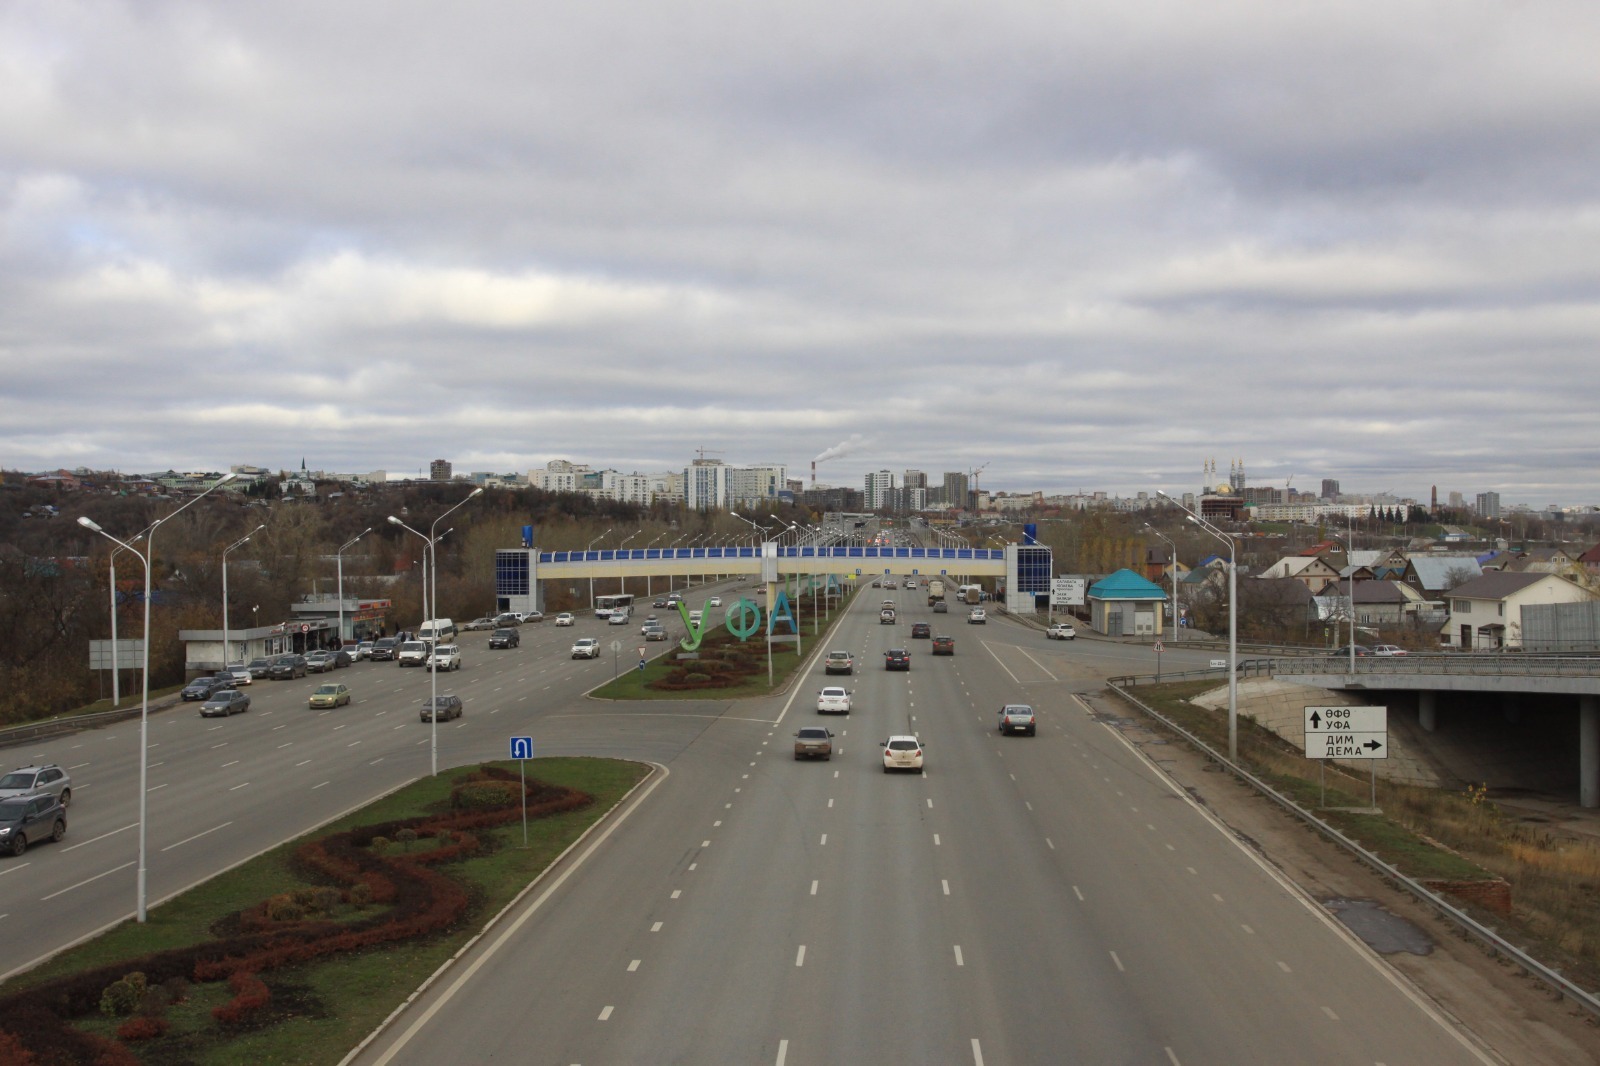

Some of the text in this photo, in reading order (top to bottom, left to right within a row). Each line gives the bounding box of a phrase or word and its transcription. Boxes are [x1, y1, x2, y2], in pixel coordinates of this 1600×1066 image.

[676, 591, 798, 651] УФА
[1325, 720, 1351, 730] УФА
[1325, 735, 1354, 746] ДИМ
[1325, 746, 1362, 757] ДЕМА
